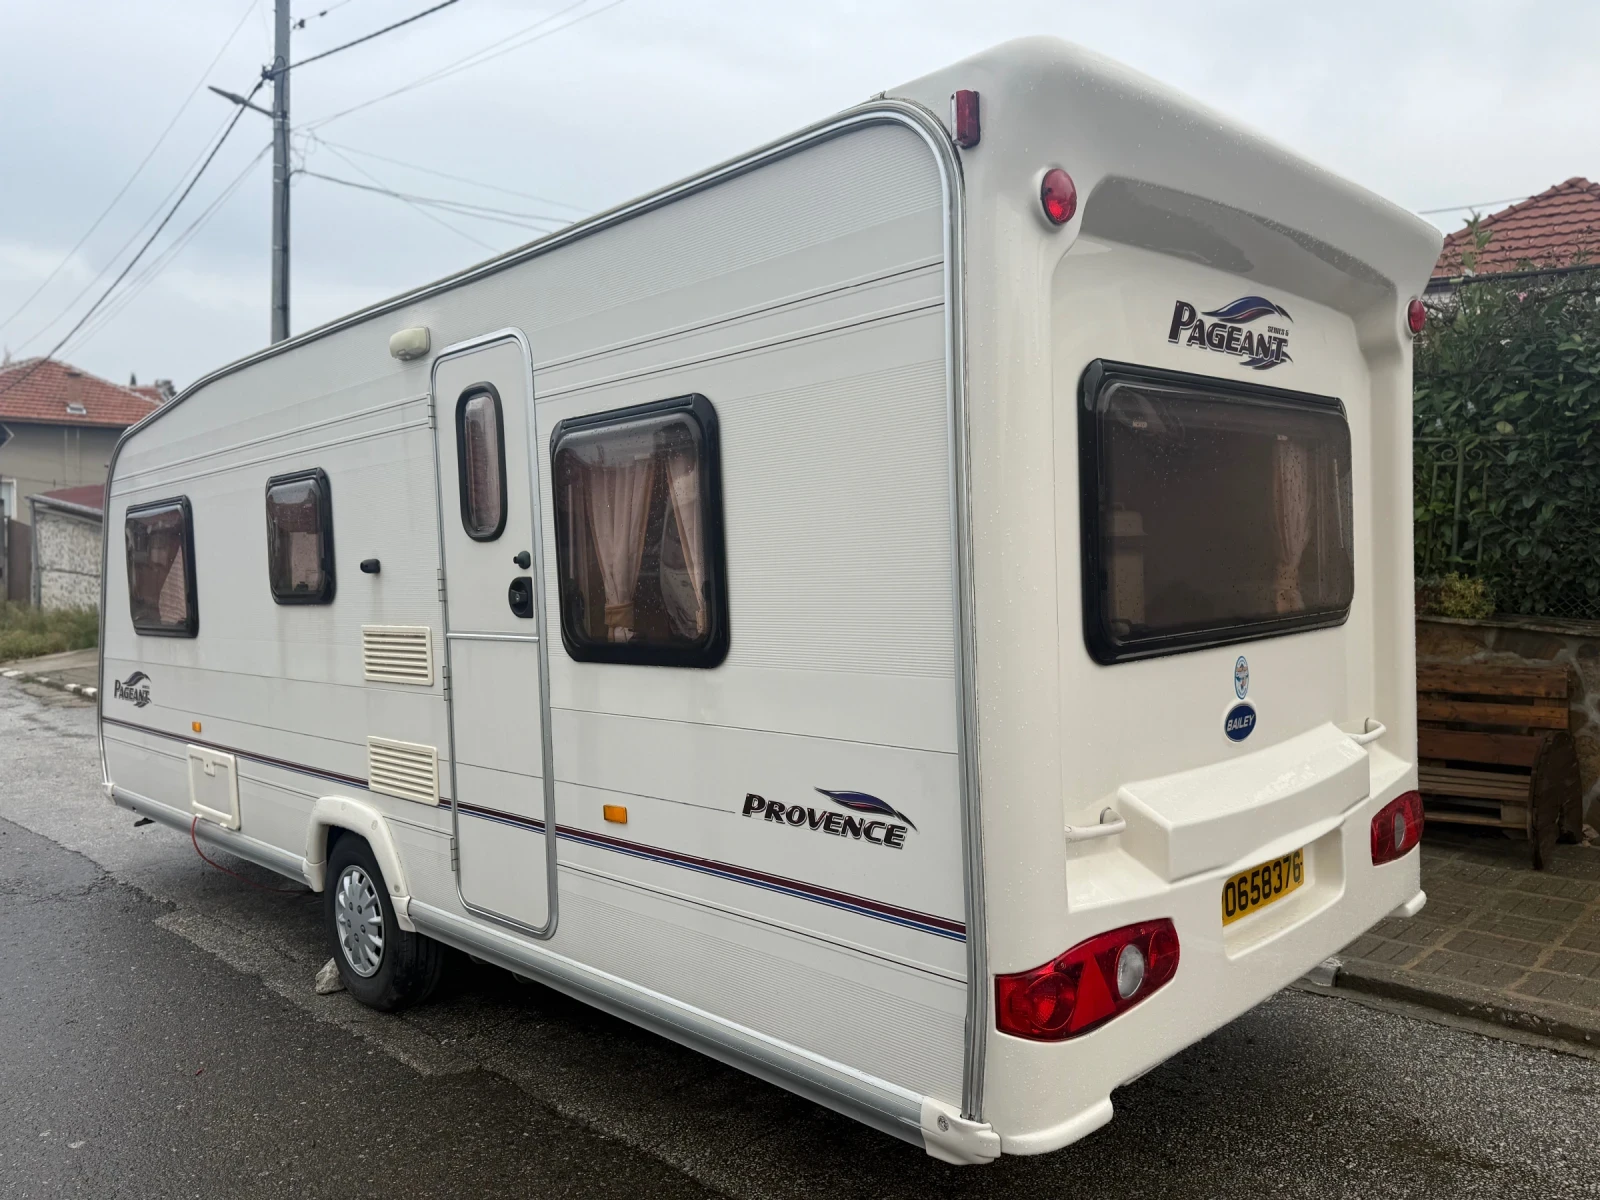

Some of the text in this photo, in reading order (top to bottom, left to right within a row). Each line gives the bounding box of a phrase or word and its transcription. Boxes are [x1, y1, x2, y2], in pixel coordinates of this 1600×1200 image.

[1168, 300, 1289, 363] PAGEANT
[114, 679, 150, 702] PAGEANT
[1226, 714, 1255, 732] BAILEY
[742, 793, 908, 850] PROVENCE
